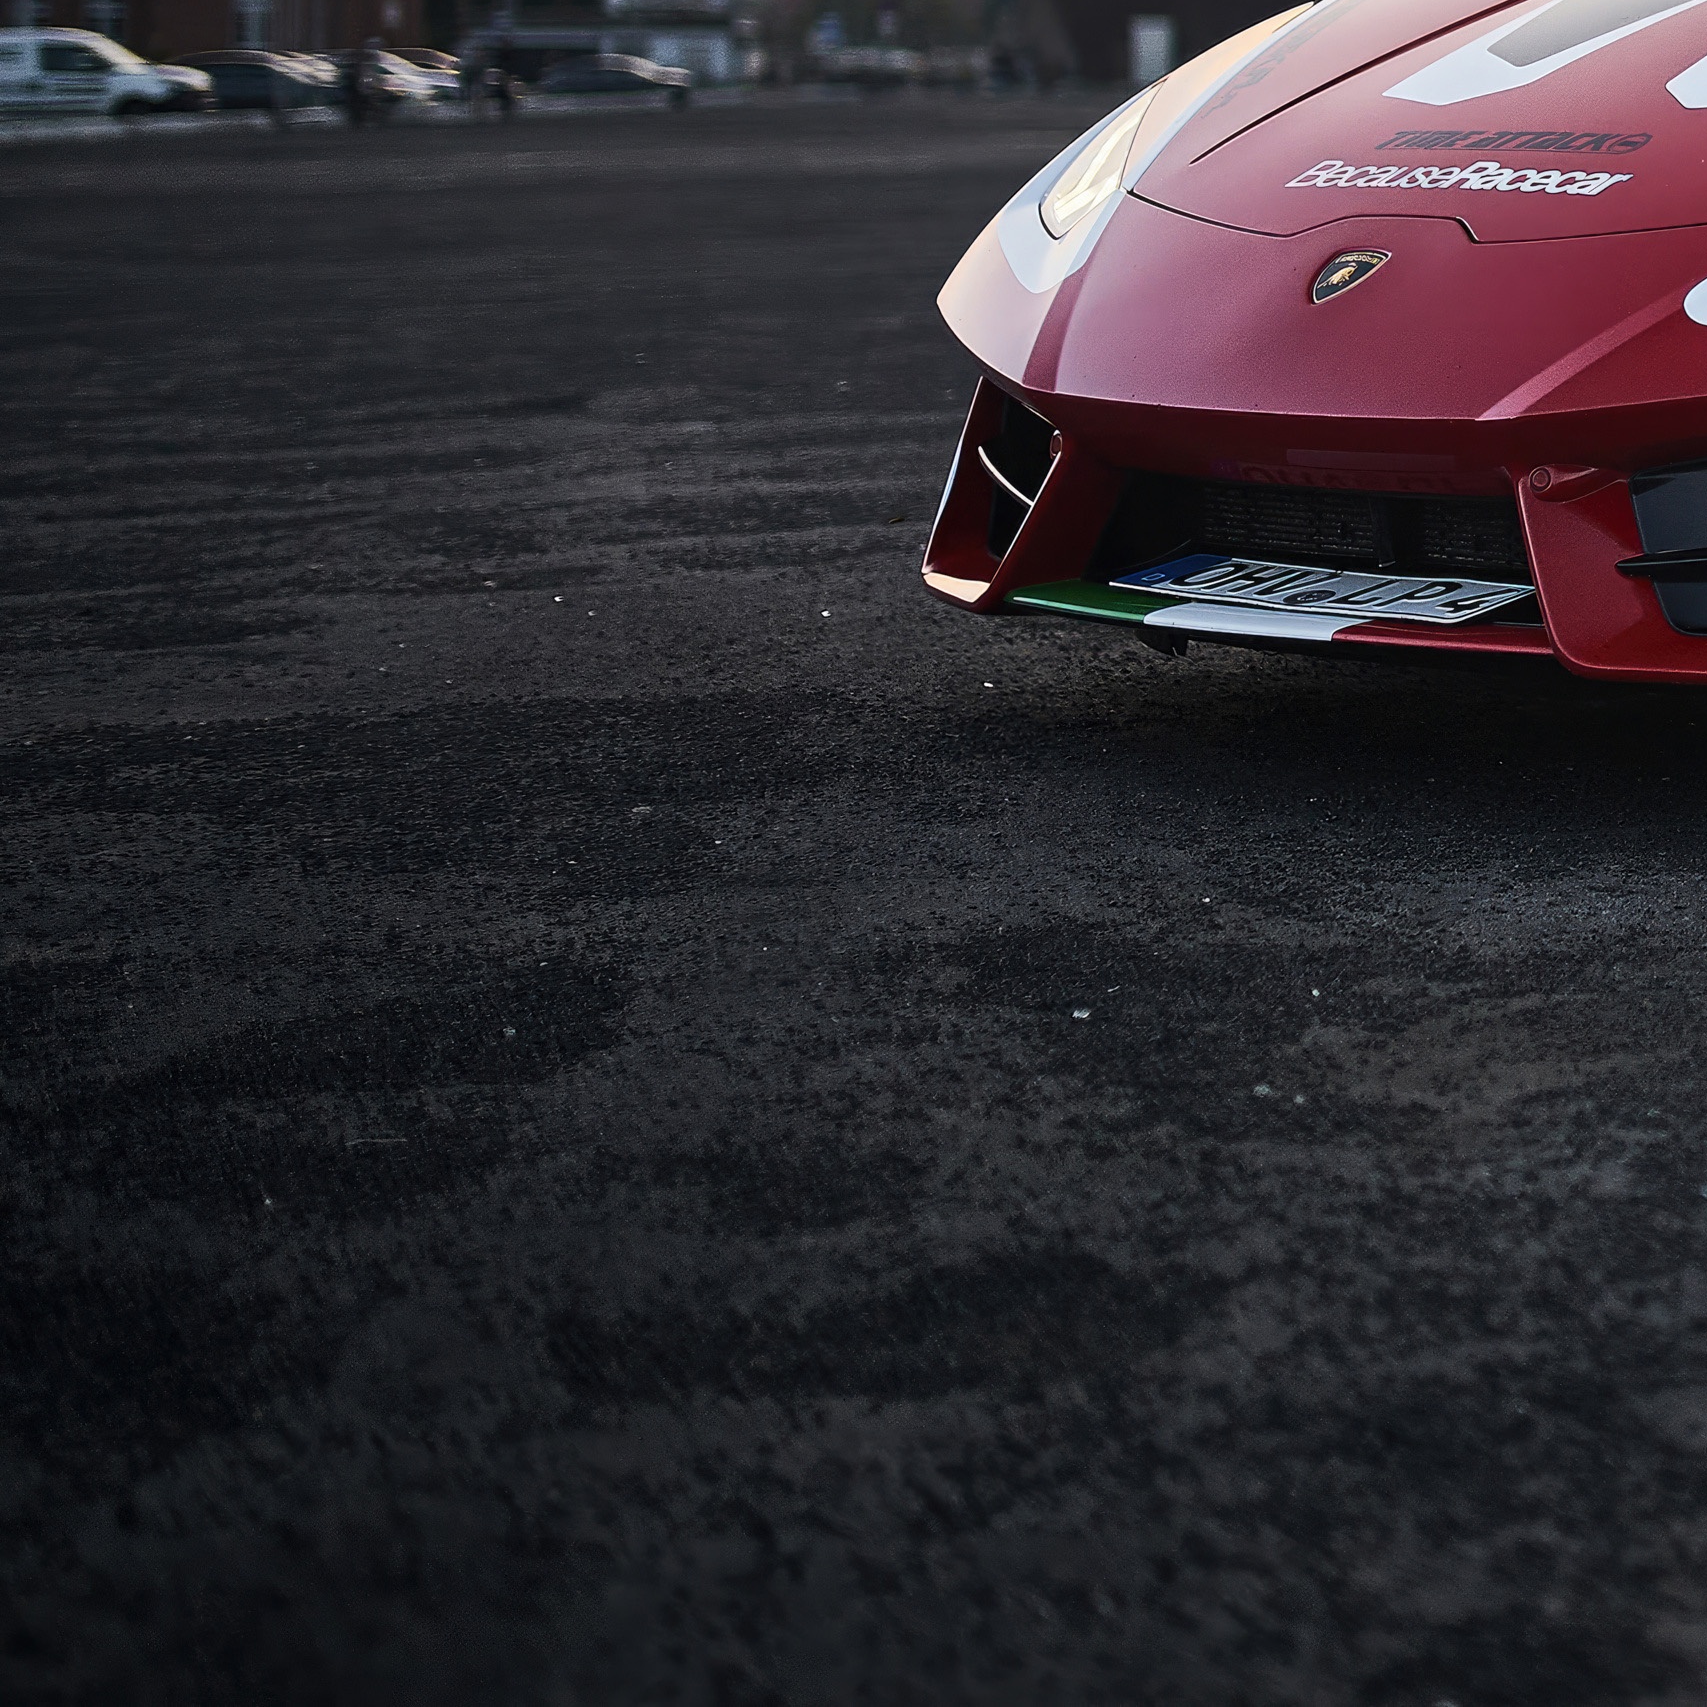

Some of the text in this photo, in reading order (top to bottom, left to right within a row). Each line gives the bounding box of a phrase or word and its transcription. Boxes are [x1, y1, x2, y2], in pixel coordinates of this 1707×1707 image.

[1285, 160, 1634, 196] BecauseRacecar
[1168, 562, 1342, 597] OHV
[1327, 578, 1464, 608] LP
